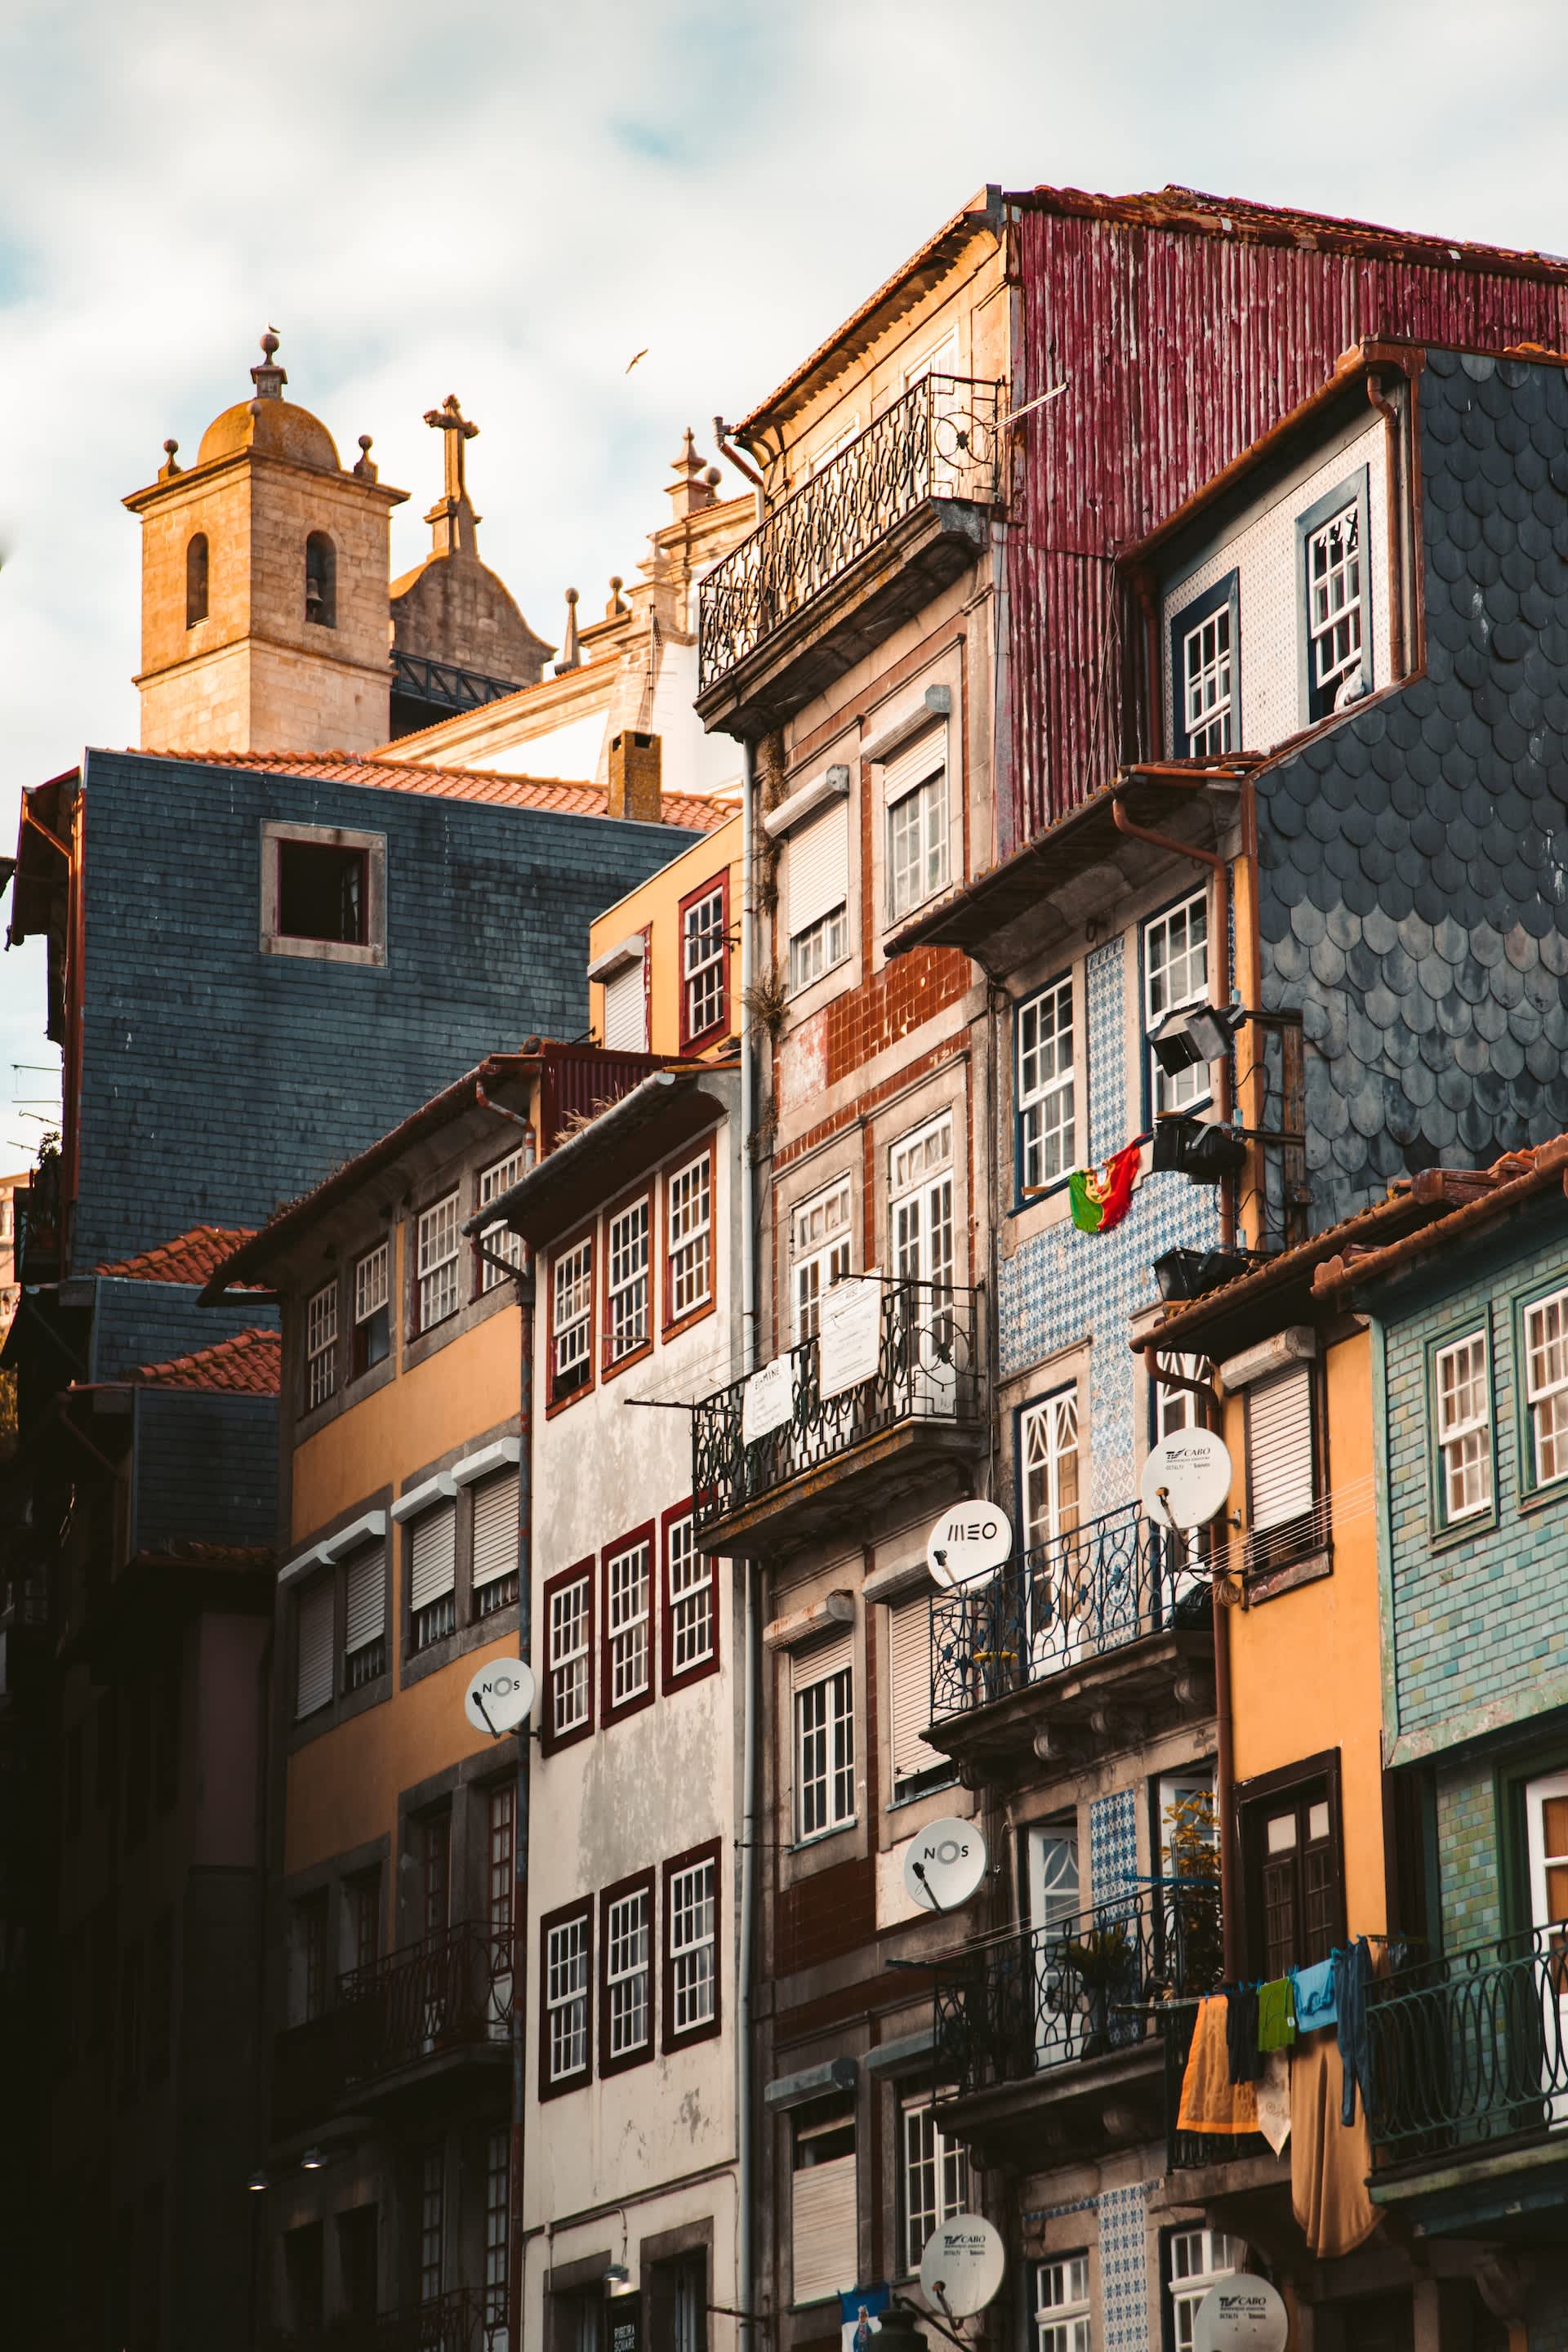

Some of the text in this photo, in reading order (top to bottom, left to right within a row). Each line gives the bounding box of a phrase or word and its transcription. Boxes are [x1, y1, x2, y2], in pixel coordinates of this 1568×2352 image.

[1184, 1447, 1210, 1457] CABO
[947, 1522, 997, 1542] MEO
[483, 1676, 520, 1697] NOS
[924, 1840, 969, 1865] NOS
[1238, 2296, 1267, 2305] CABO
[614, 2324, 635, 2338] RIBEIRA
